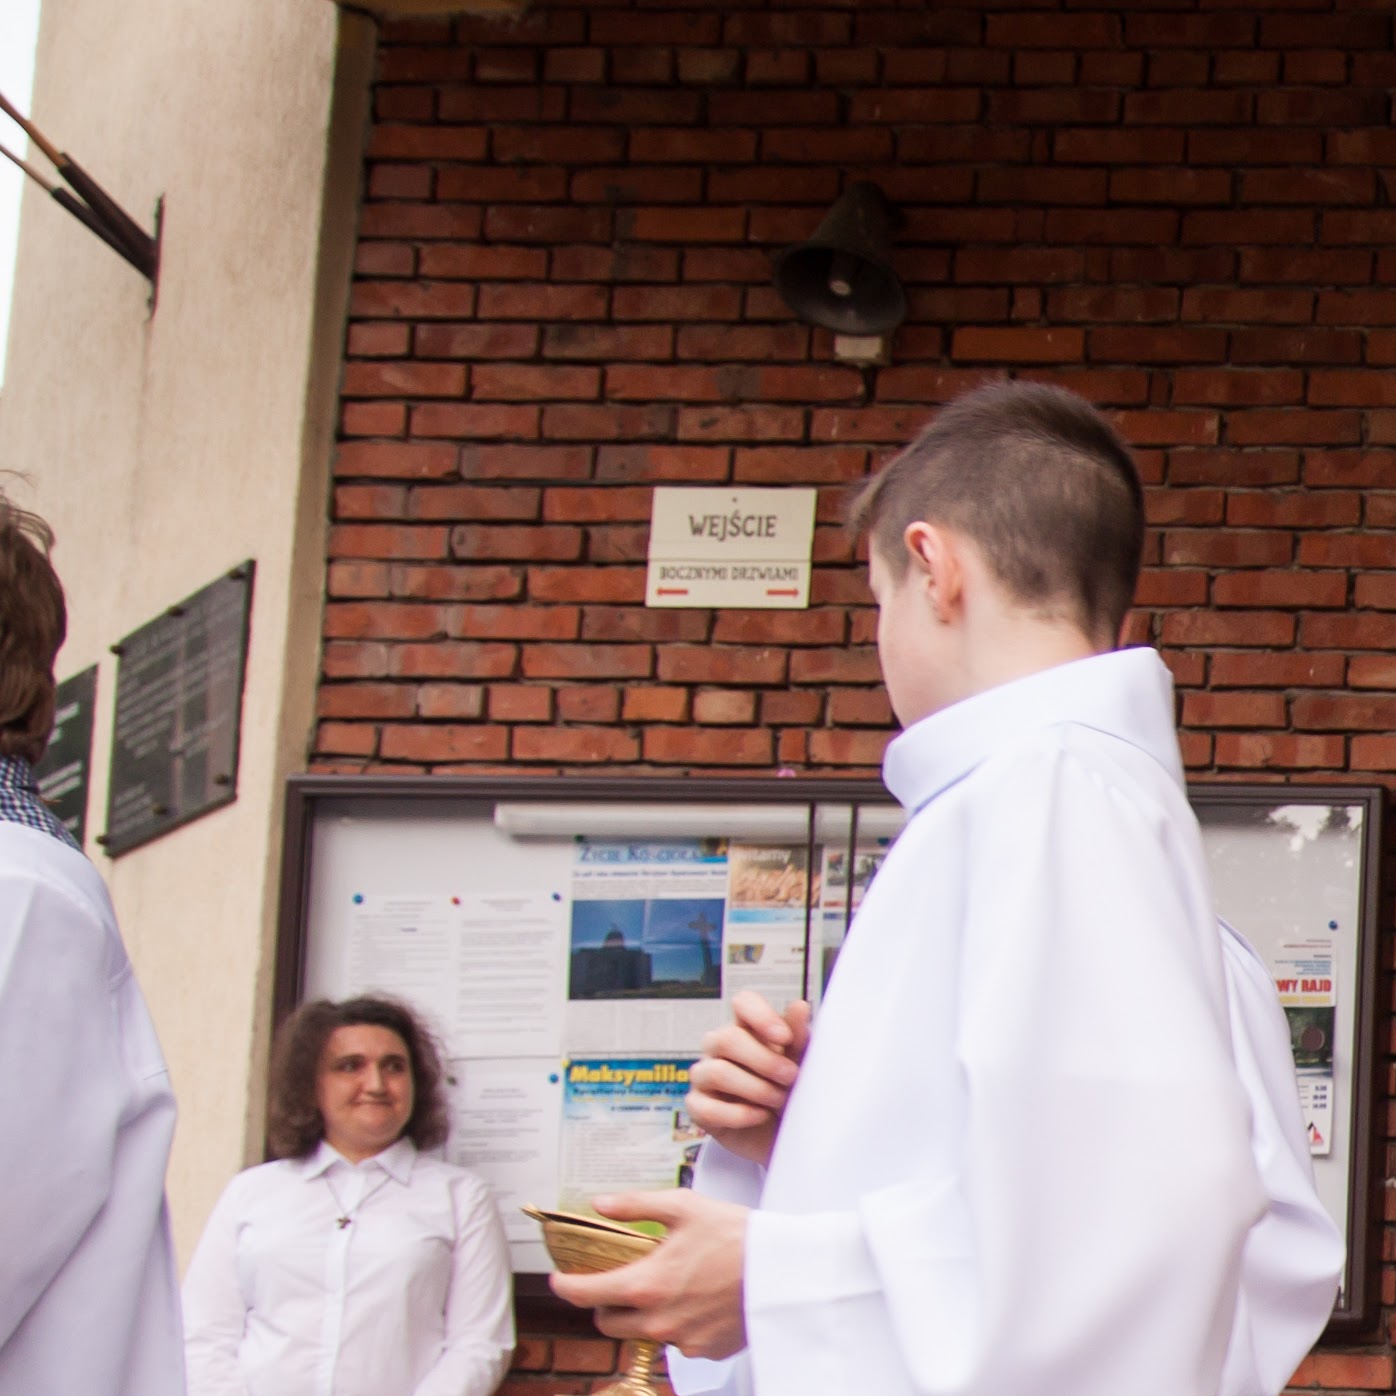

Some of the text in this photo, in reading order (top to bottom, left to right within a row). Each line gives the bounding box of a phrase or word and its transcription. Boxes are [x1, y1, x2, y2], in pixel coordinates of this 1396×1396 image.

[689, 510, 778, 542] WEJŚCIE
[660, 566, 800, 581] BOCZNYMI DRZWIAMI
[1276, 979, 1332, 992] WY RAJD
[570, 1064, 690, 1087] Maksymilia
